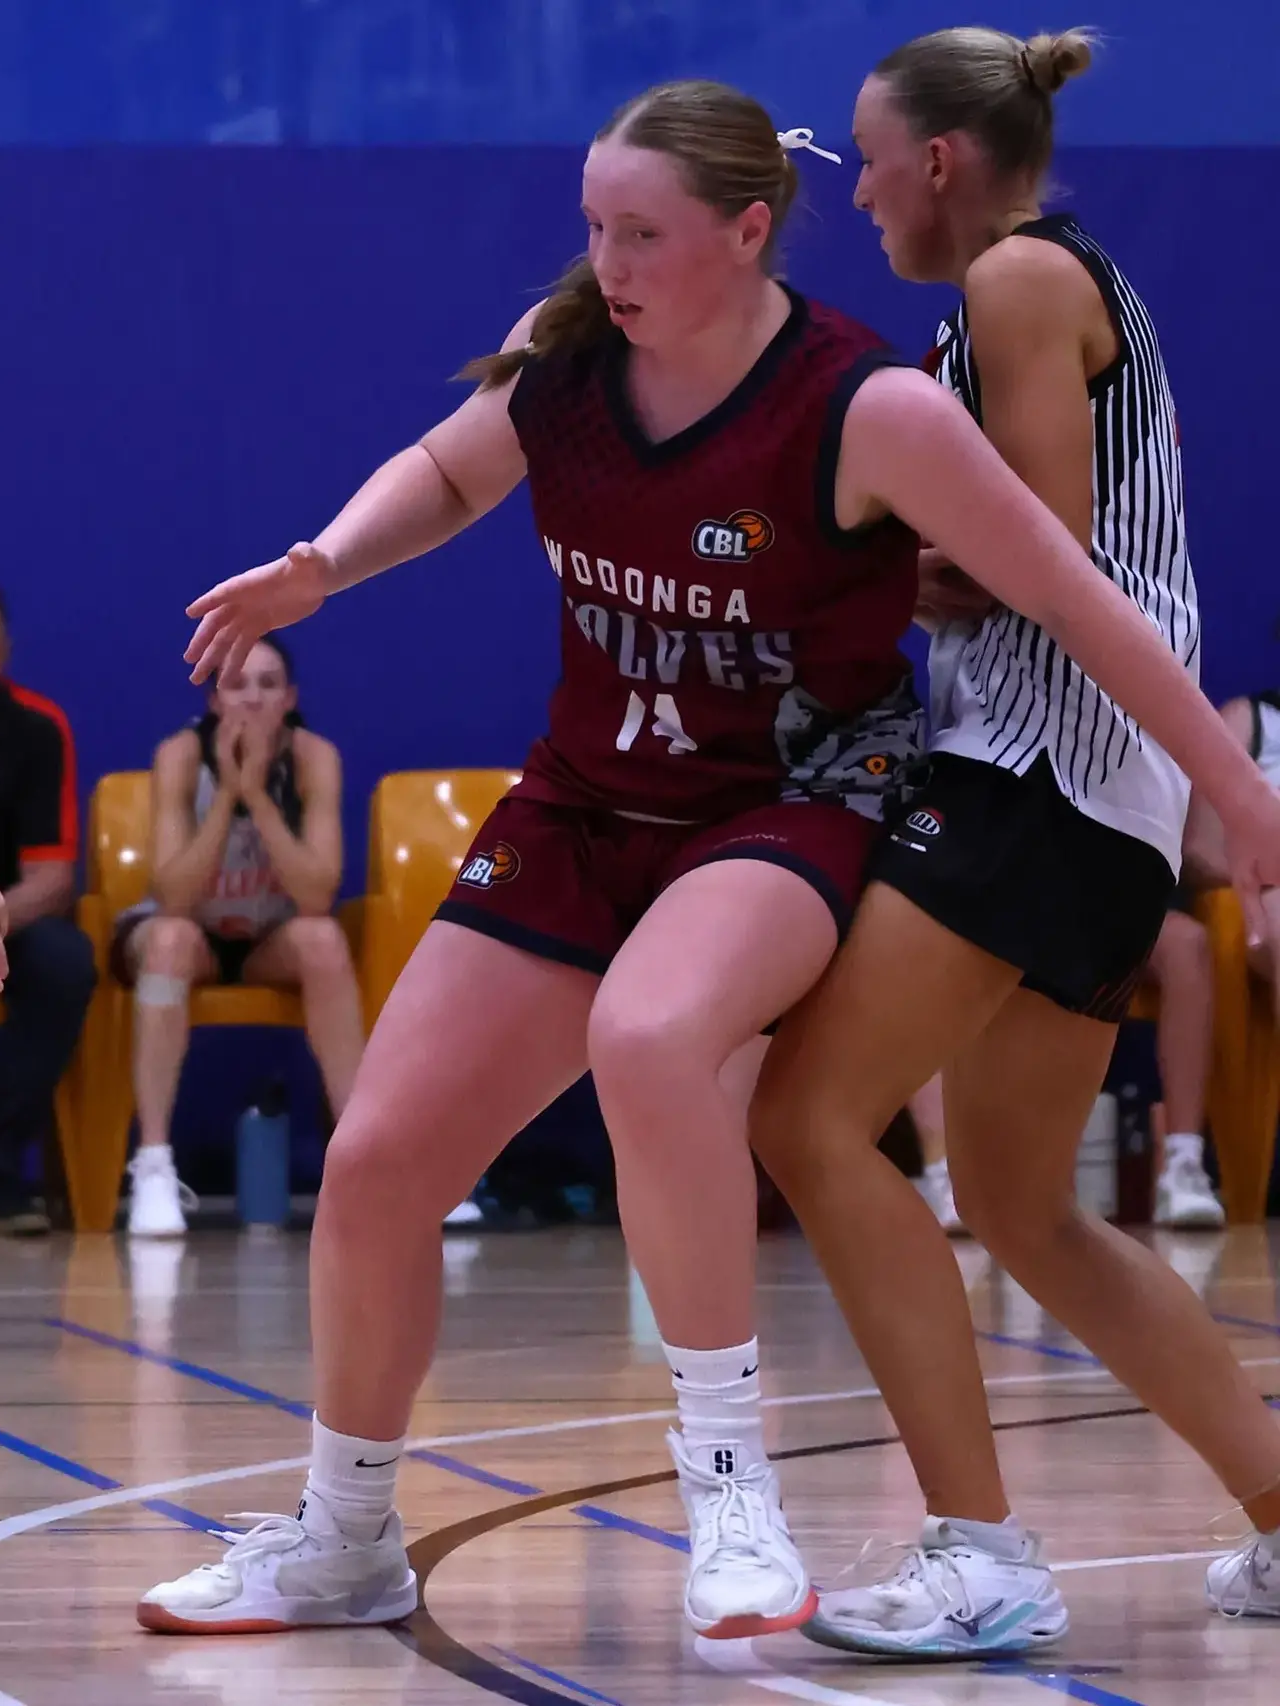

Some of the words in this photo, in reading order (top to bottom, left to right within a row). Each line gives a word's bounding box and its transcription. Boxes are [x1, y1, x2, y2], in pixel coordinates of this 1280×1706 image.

[544, 535, 751, 624] WODONGA
[697, 526, 746, 557] CBL
[566, 596, 795, 691] OLVES
